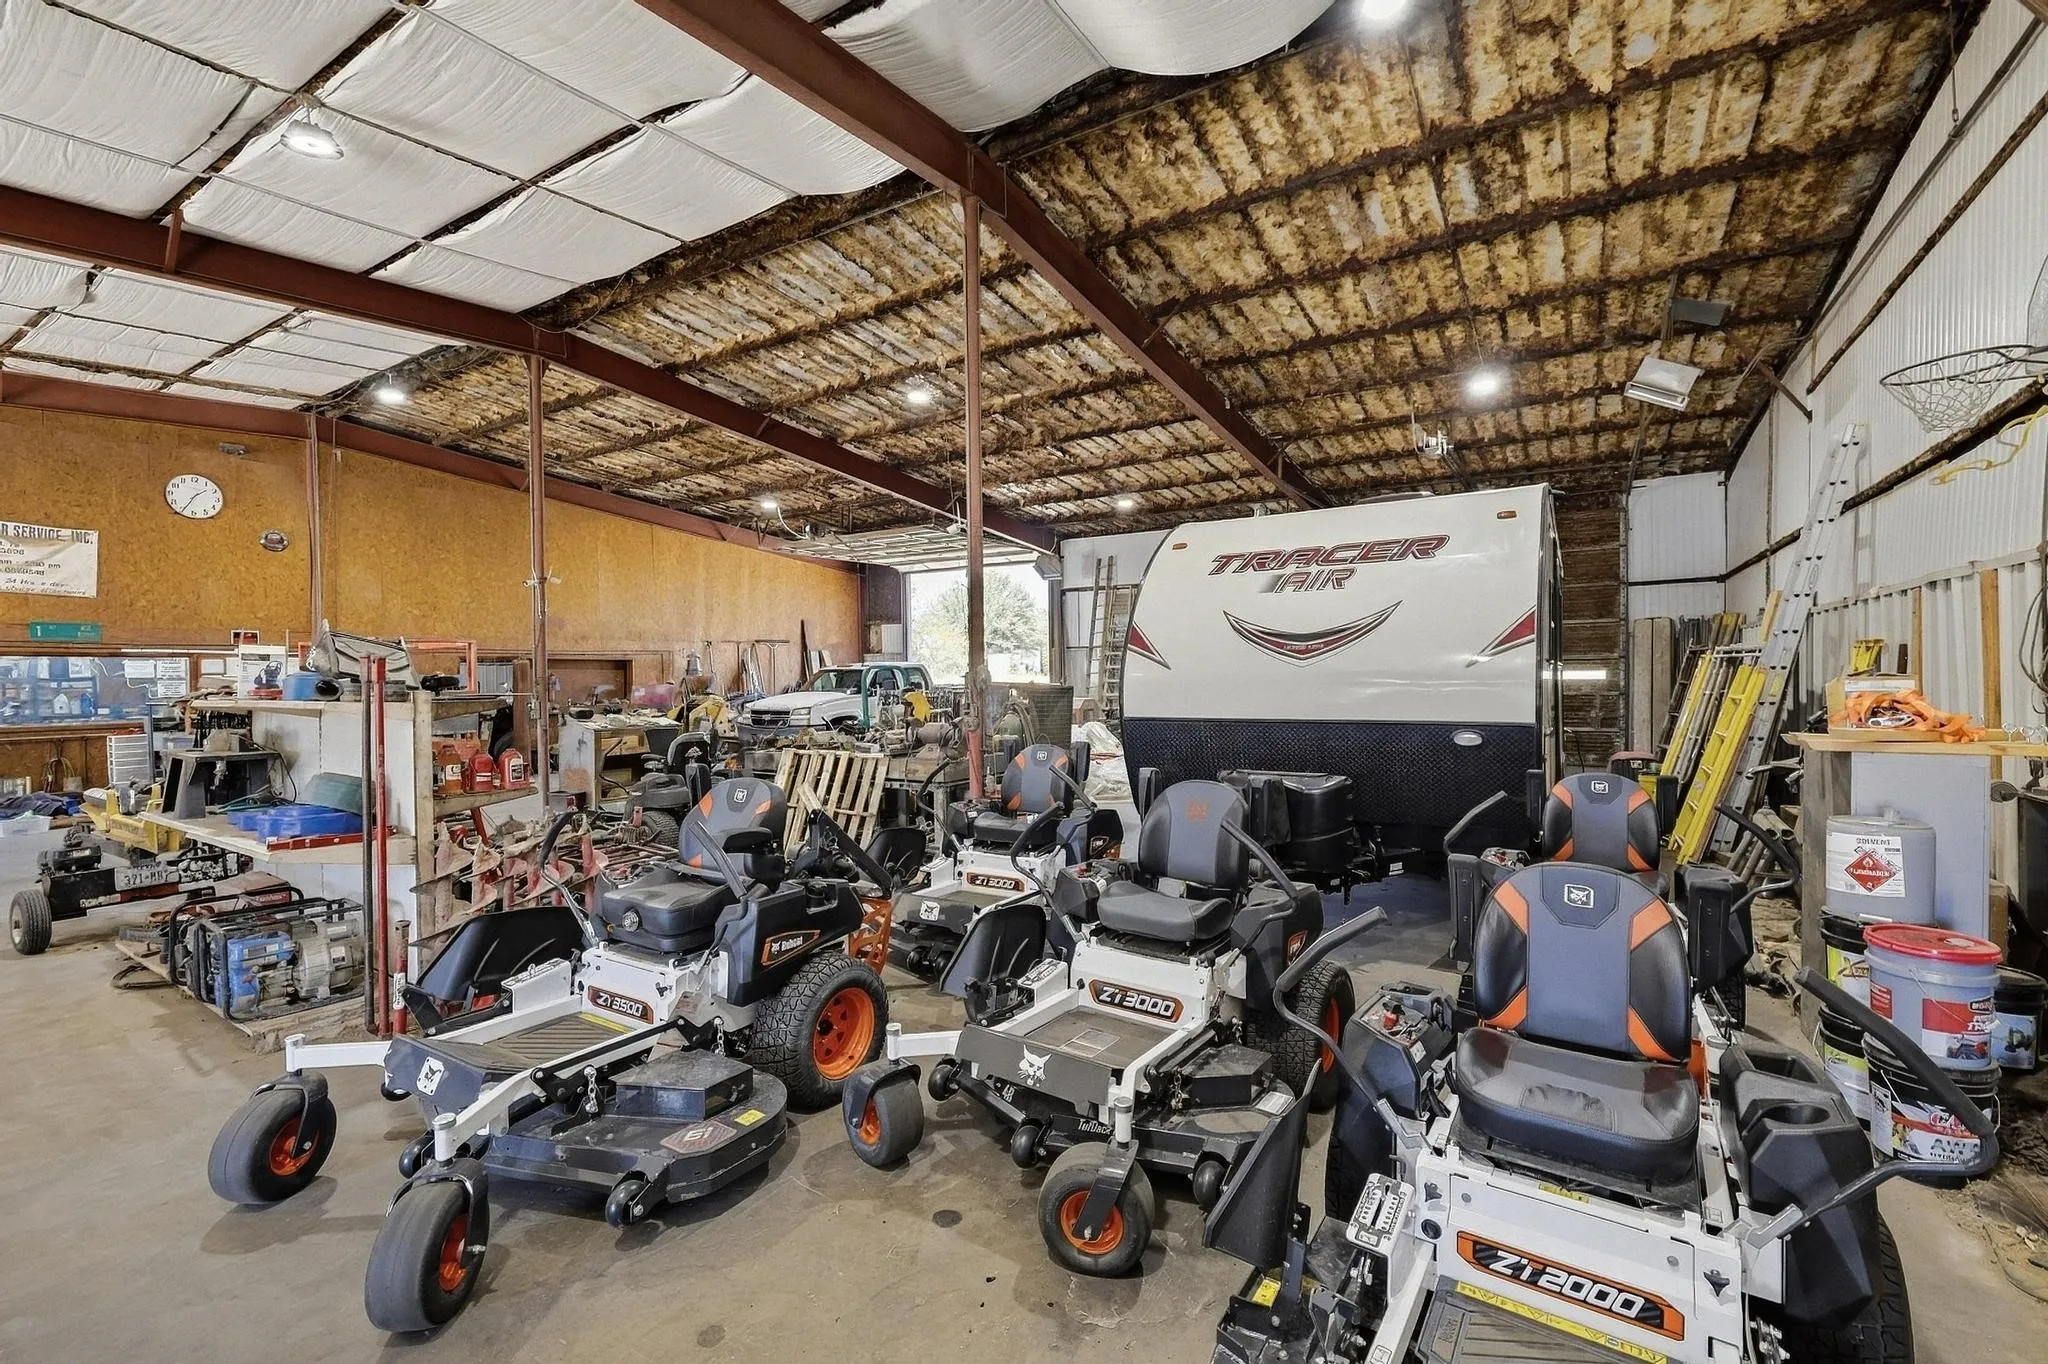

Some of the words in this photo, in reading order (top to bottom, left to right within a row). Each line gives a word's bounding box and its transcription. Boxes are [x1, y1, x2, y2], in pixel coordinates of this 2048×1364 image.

[13, 525, 64, 541] SERVICE
[71, 530, 94, 544] INC.
[1208, 534, 1450, 575] TRACER
[1274, 568, 1357, 593] AIR
[1856, 837, 1892, 846] SOLVENT
[1099, 986, 1176, 1017] ZT3000
[1488, 1250, 1646, 1319] ZT2000
